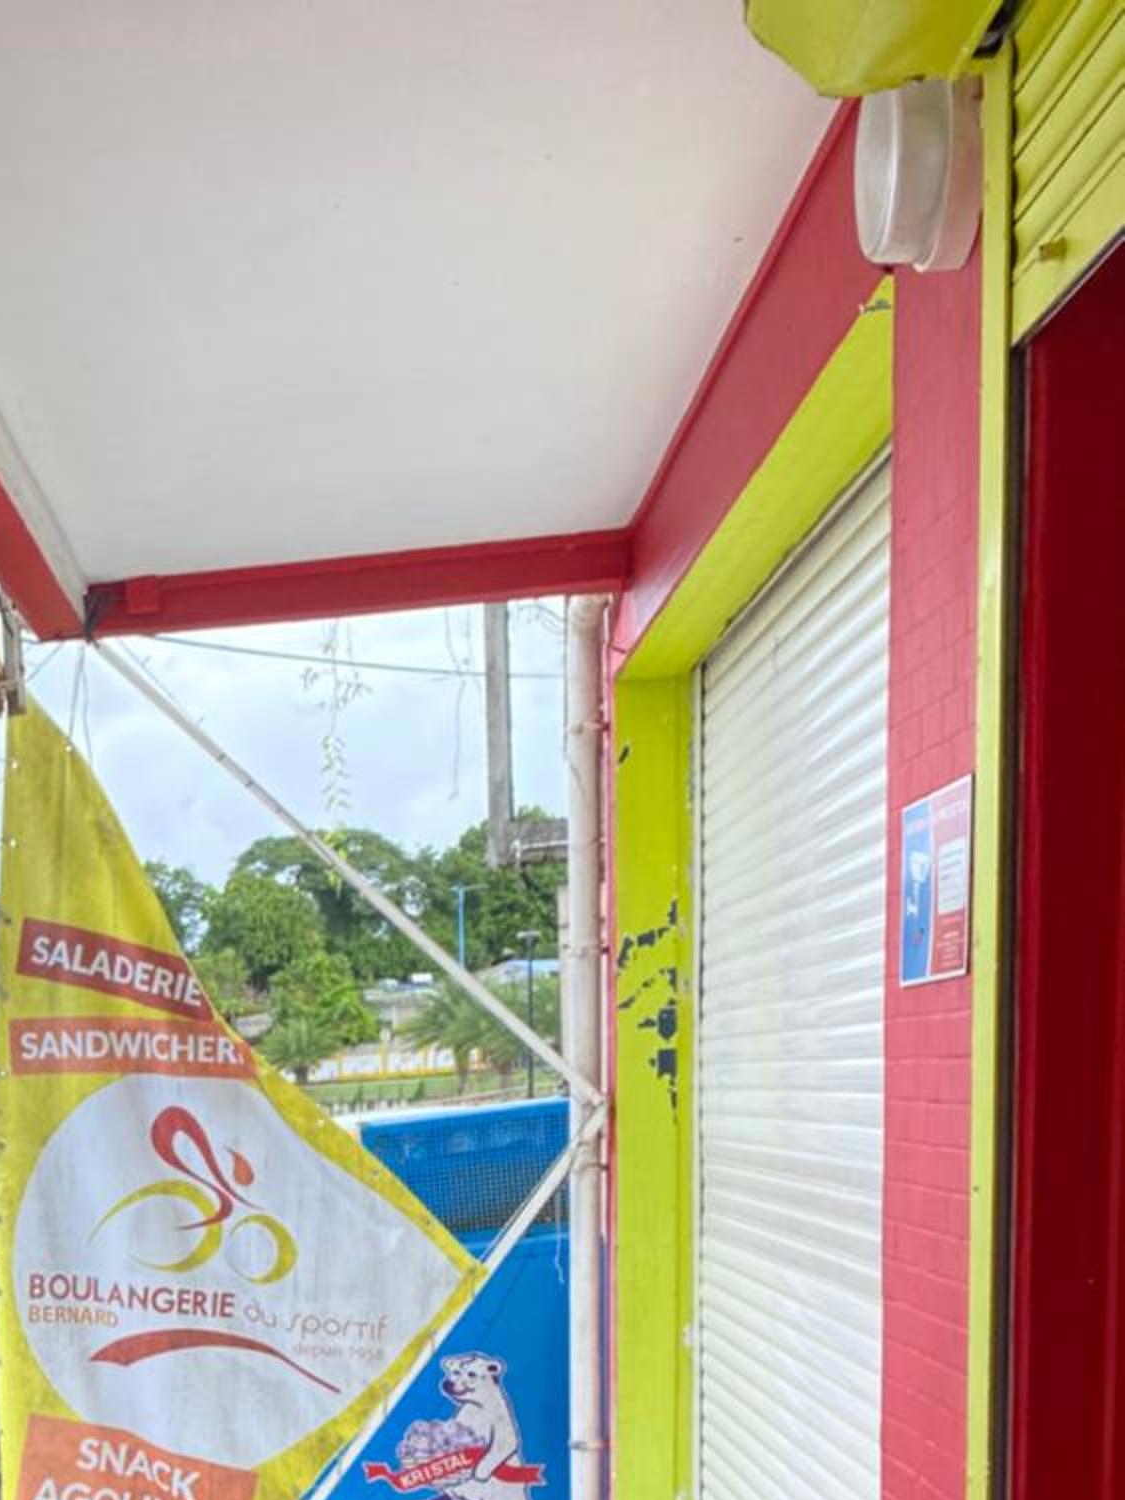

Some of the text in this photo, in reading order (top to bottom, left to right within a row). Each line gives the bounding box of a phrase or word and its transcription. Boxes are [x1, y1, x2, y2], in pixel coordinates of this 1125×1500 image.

[31, 936, 202, 1007] SALADERIE
[28, 1272, 236, 1319] BOULANGERIE
[244, 1299, 277, 1328] du
[28, 1304, 119, 1327] BERNARD
[399, 1451, 474, 1489] KRISTAL
